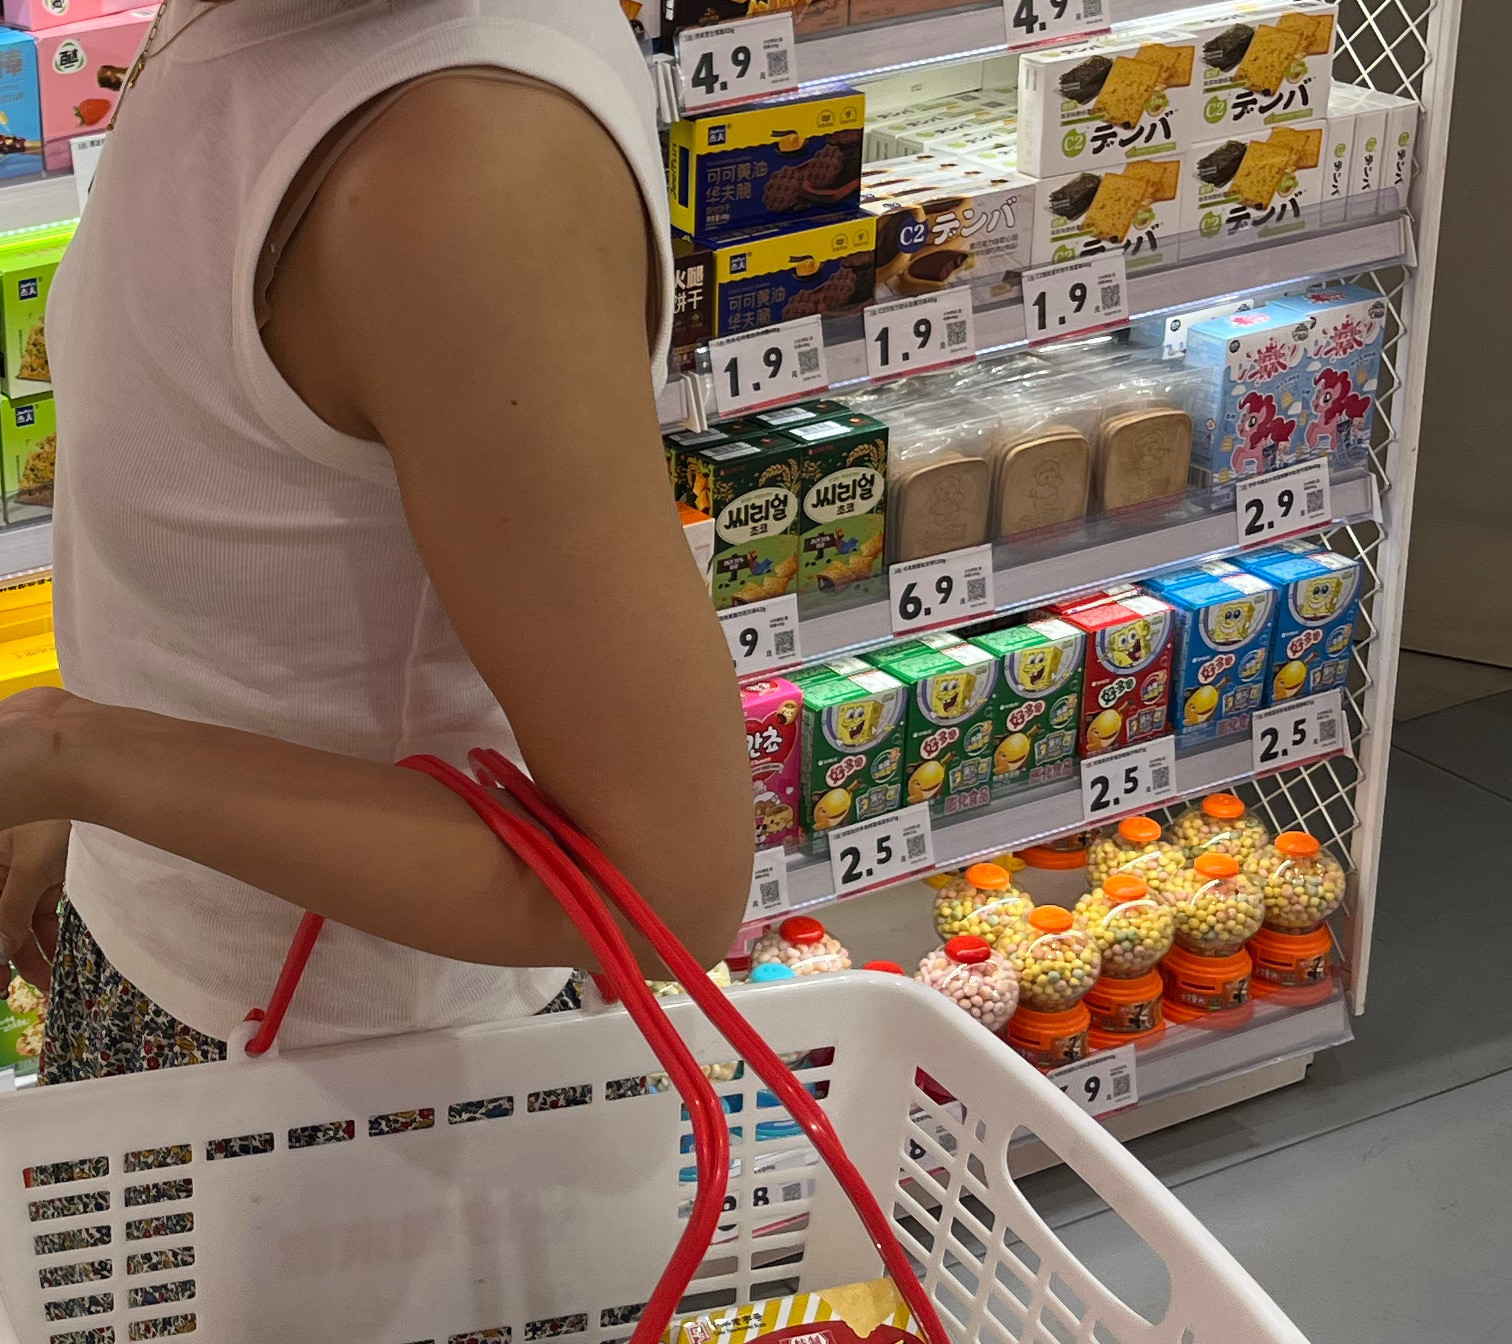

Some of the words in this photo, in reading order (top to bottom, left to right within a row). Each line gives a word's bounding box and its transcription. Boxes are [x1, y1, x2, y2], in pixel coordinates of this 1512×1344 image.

[691, 45, 752, 95] 4.9
[706, 180, 751, 204] 华夫脆
[707, 158, 767, 183] 可可黄油
[900, 225, 925, 244] C2
[1032, 283, 1088, 330] 1.9
[875, 317, 932, 366] 1.9
[724, 346, 783, 397] 1.9
[724, 495, 787, 531] 씨리얼
[750, 522, 768, 535] 초코
[1245, 489, 1294, 536] 2.9
[899, 575, 954, 620] 6.9
[1259, 718, 1308, 764] 2.5
[1090, 765, 1140, 813] 2.5
[839, 834, 893, 884] 2.5
